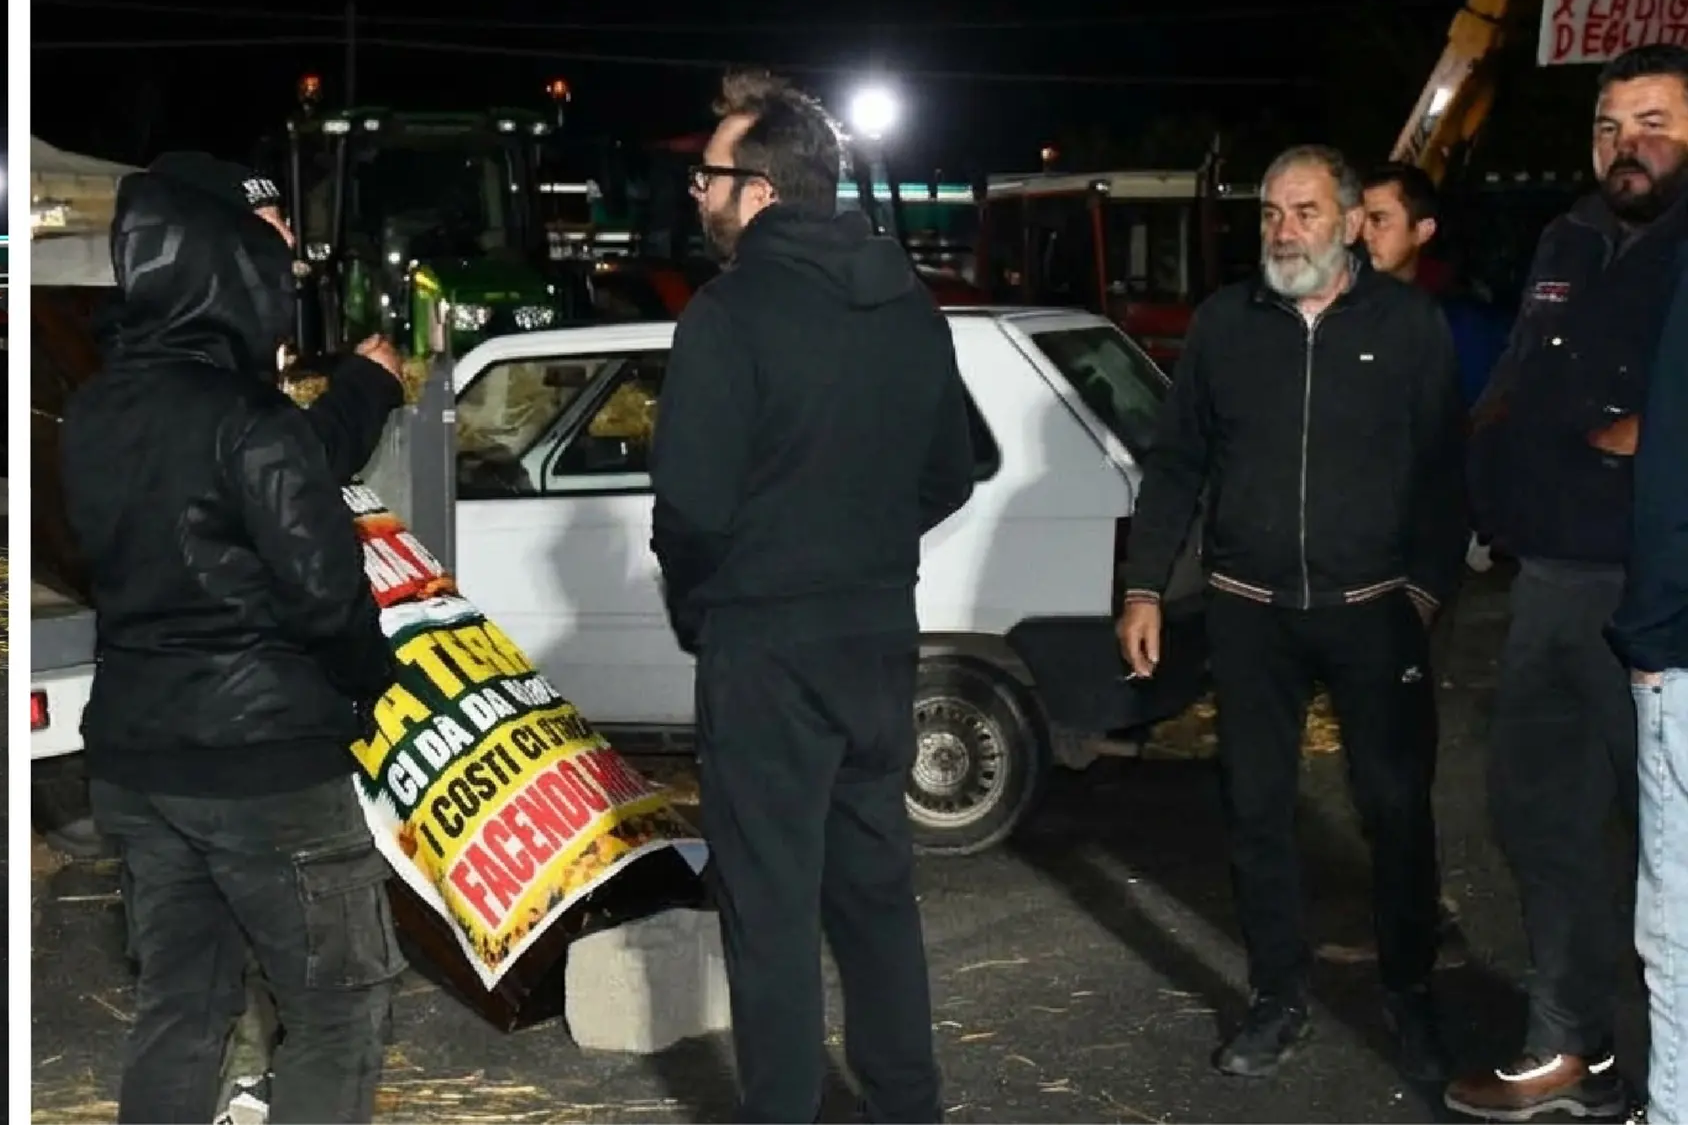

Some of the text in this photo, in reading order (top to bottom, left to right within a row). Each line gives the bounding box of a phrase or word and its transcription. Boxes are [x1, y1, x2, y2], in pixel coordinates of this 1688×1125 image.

[510, 724, 551, 761] CI
[386, 749, 429, 806] CI
[430, 742, 523, 839] COSTI
[419, 822, 445, 859] I
[448, 758, 611, 930] FACENDO
